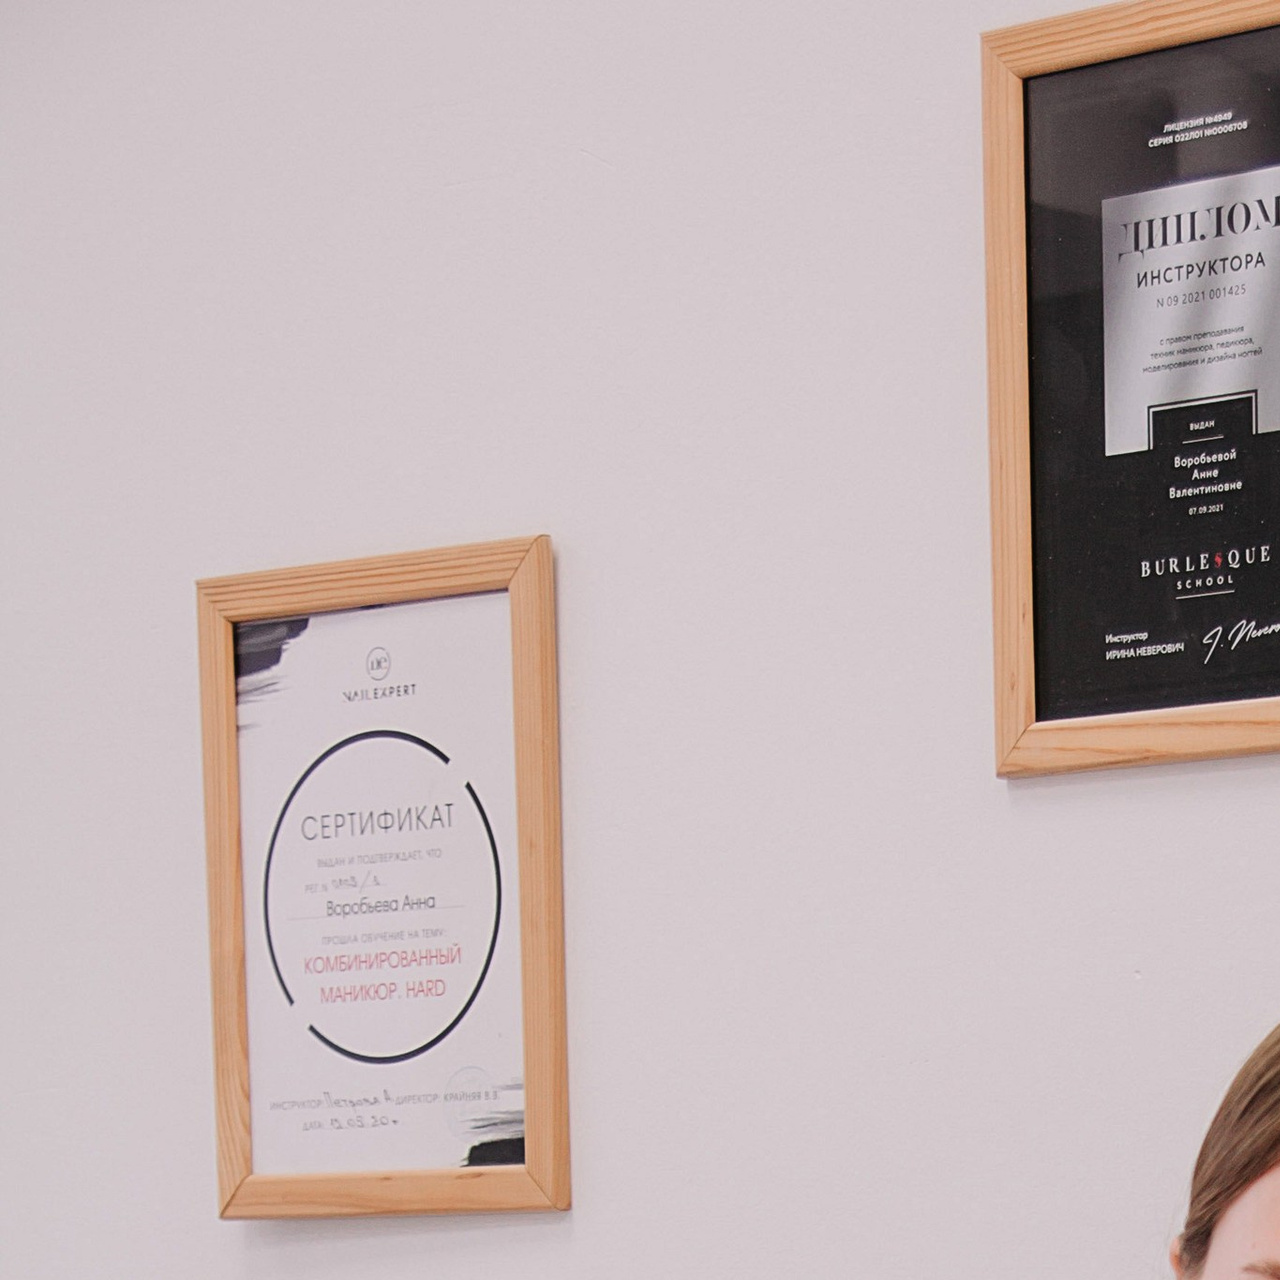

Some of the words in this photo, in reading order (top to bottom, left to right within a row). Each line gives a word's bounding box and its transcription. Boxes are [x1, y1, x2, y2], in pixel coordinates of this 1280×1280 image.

[1163, 118, 1204, 133] ЛИЦЕНЗИЯ
[1148, 136, 1173, 148] СЕРИЯ
[1136, 252, 1266, 289] ИНСТРУКТОРА
[1167, 295, 1179, 307] 09
[1181, 291, 1206, 305] 2021
[1166, 335, 1192, 346] правом
[1193, 326, 1244, 341] преподавания
[1189, 420, 1215, 431] ВЫДАН
[1174, 449, 1237, 468] Воробьевой
[1191, 468, 1219, 481] Анне
[1169, 480, 1243, 499] Валентиновне
[1188, 504, 1224, 516] 07.09.2021
[1140, 545, 1271, 578] BURLESQUE
[1176, 575, 1234, 589] SCHOOL
[1105, 631, 1148, 644] Инструктор
[1105, 647, 1135, 661] ИРИНА
[1136, 642, 1184, 657] НЕВЕРОВИЧ
[301, 803, 454, 841] СЕРТИФИКАТ
[326, 896, 399, 920] Воробьева
[401, 893, 436, 911] Анна
[304, 943, 462, 975] КОМБИНИРОВАННЫЙ
[406, 979, 446, 999] HARD
